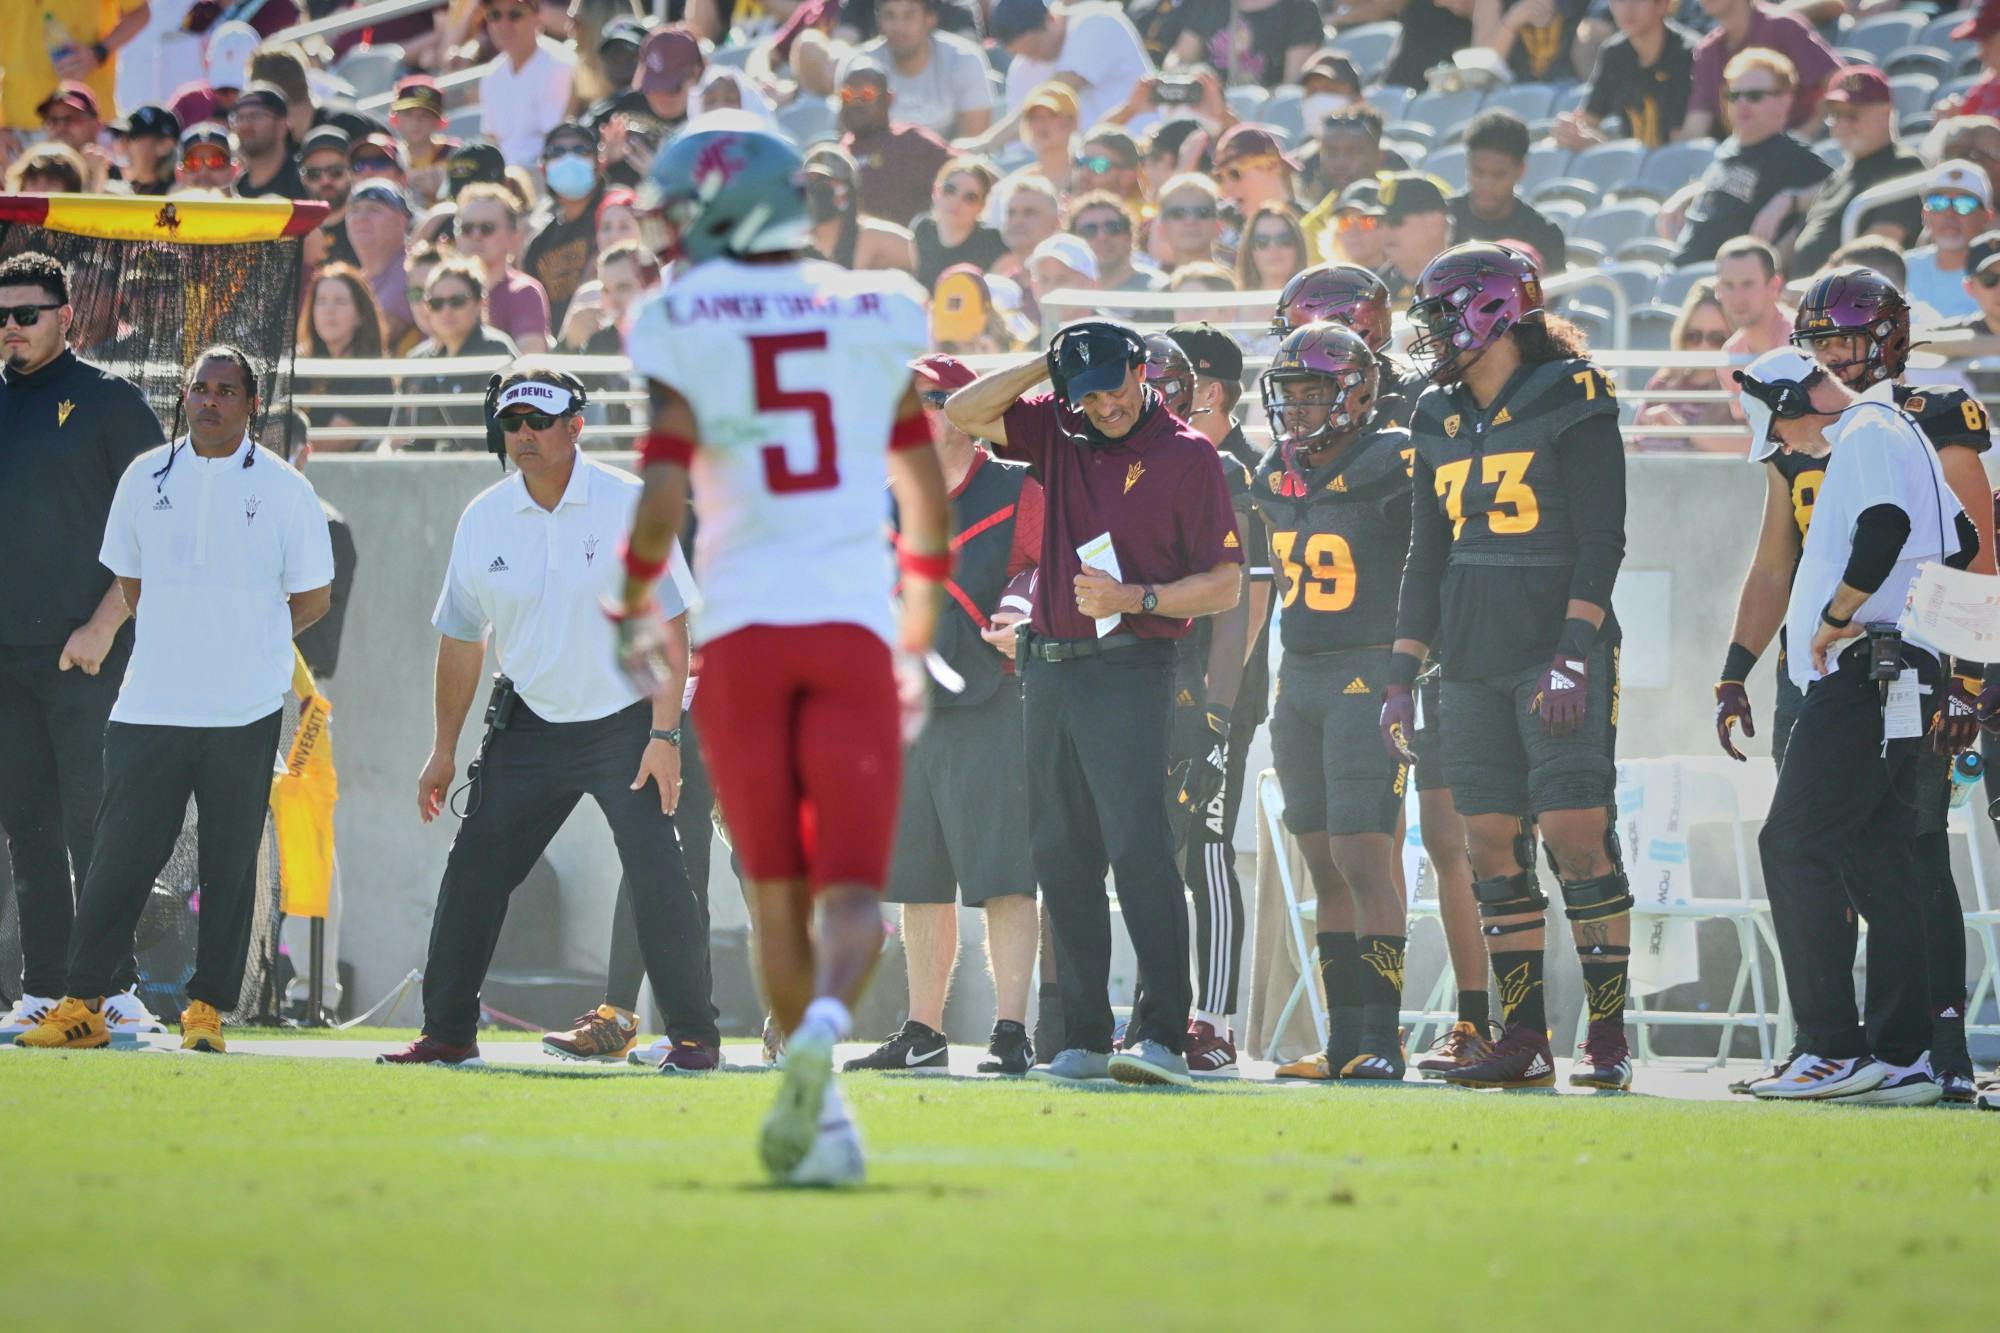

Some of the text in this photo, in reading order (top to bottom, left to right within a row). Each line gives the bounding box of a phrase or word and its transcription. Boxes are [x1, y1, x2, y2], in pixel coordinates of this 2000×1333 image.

[520, 386, 553, 399] DEVILS
[744, 330, 840, 498] 5
[1434, 452, 1540, 543] 73
[1271, 530, 1357, 612] 39
[287, 705, 325, 778] UNIVERSITY
[1524, 1063, 1552, 1078] adidas
